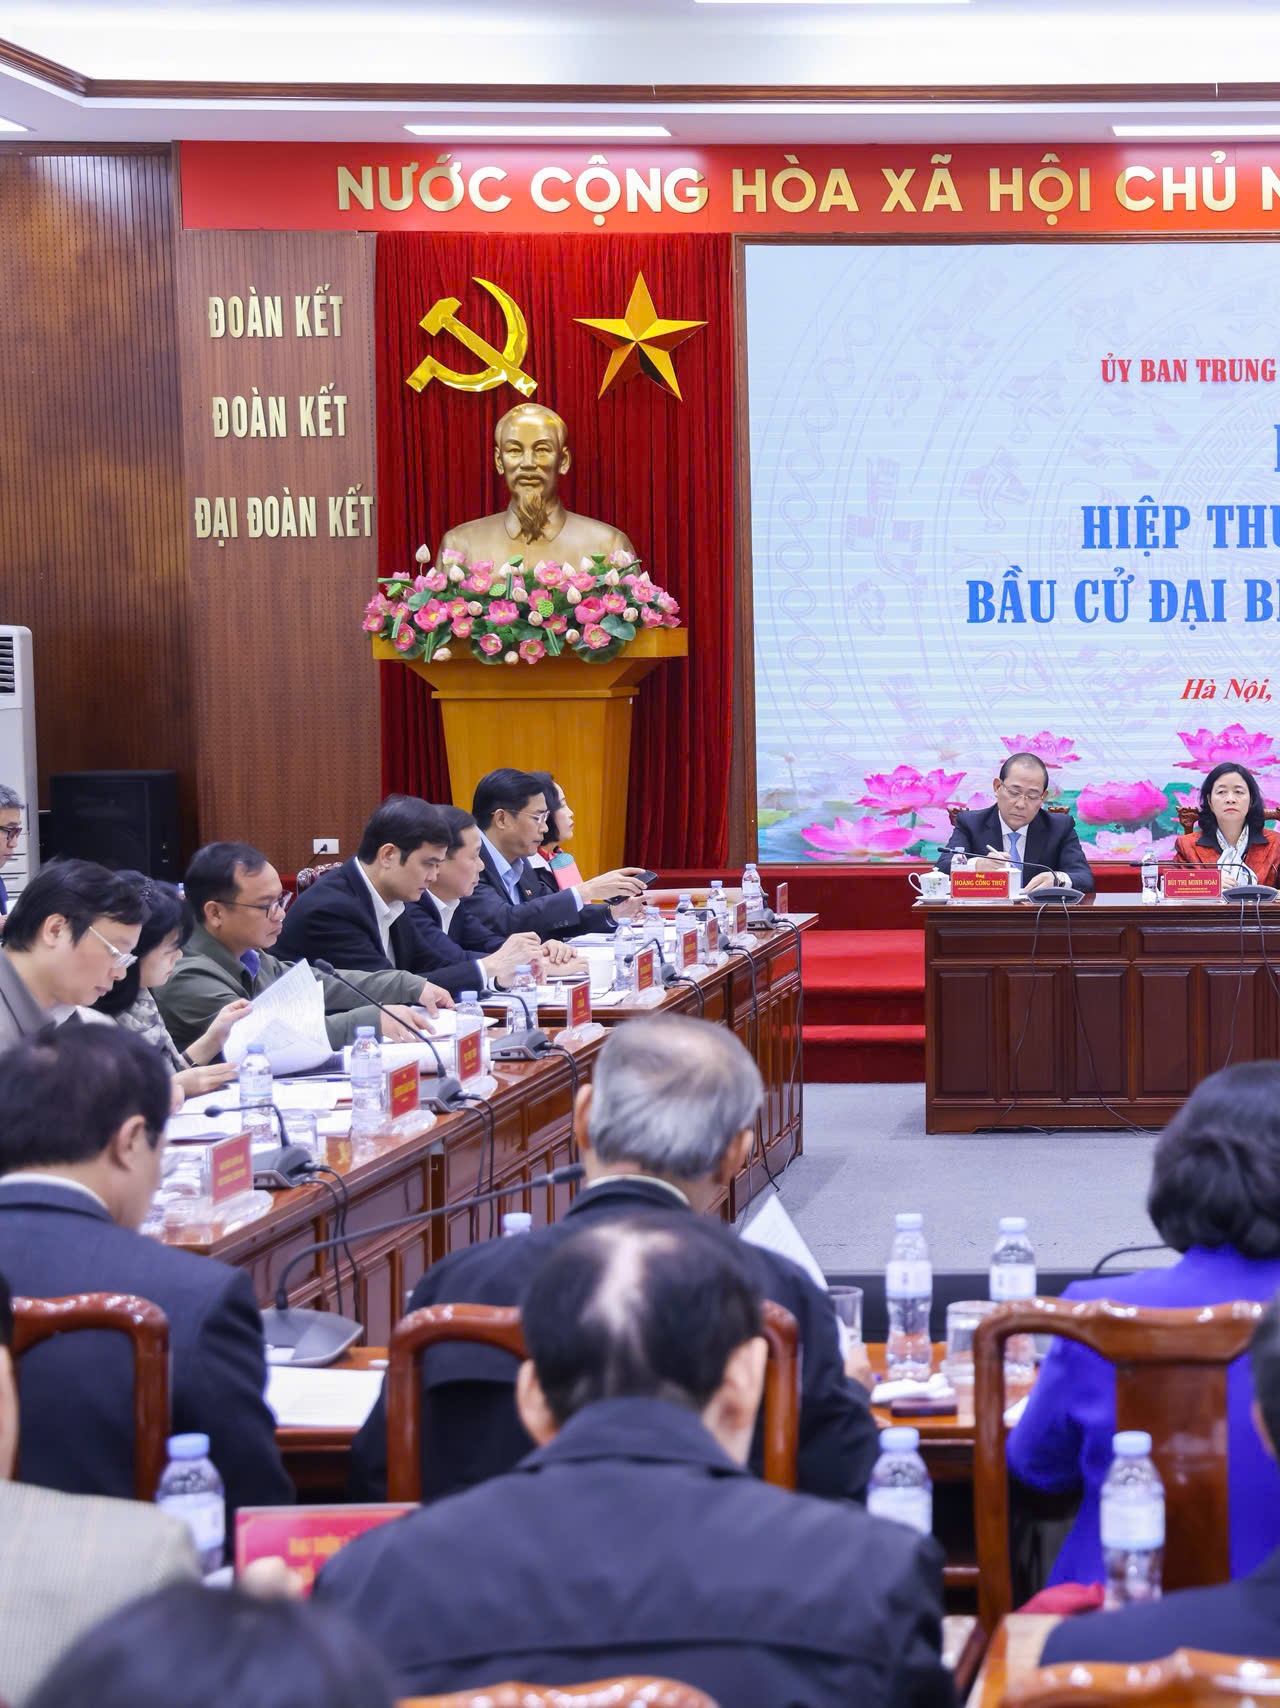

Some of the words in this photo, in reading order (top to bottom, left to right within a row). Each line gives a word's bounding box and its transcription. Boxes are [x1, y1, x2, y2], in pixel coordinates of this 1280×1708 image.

[337, 153, 511, 213] NƯỚC
[531, 154, 709, 226] CỘNG
[733, 155, 859, 213] HÒA
[881, 154, 964, 213] XÃ
[989, 153, 1091, 225] HỘI
[1116, 150, 1237, 211] CHỦ
[208, 286, 283, 338] ĐOÀN
[295, 283, 343, 337] KẾT
[1101, 352, 1132, 383] ỦY
[1140, 359, 1187, 383] BAN
[1196, 359, 1276, 382] TRUNG
[212, 387, 287, 438] ĐOÀN
[299, 382, 347, 437] KẾT
[194, 496, 238, 547] ĐẠI
[247, 487, 317, 538] ĐOÀN
[328, 483, 374, 537] KẾT
[1081, 495, 1190, 557] HIỆP
[966, 565, 1057, 624] BẦU
[1074, 566, 1135, 624] CỬ
[1149, 578, 1227, 631] ĐẠI
[1180, 678, 1217, 699] Hà
[1224, 678, 1272, 703] Nội,
